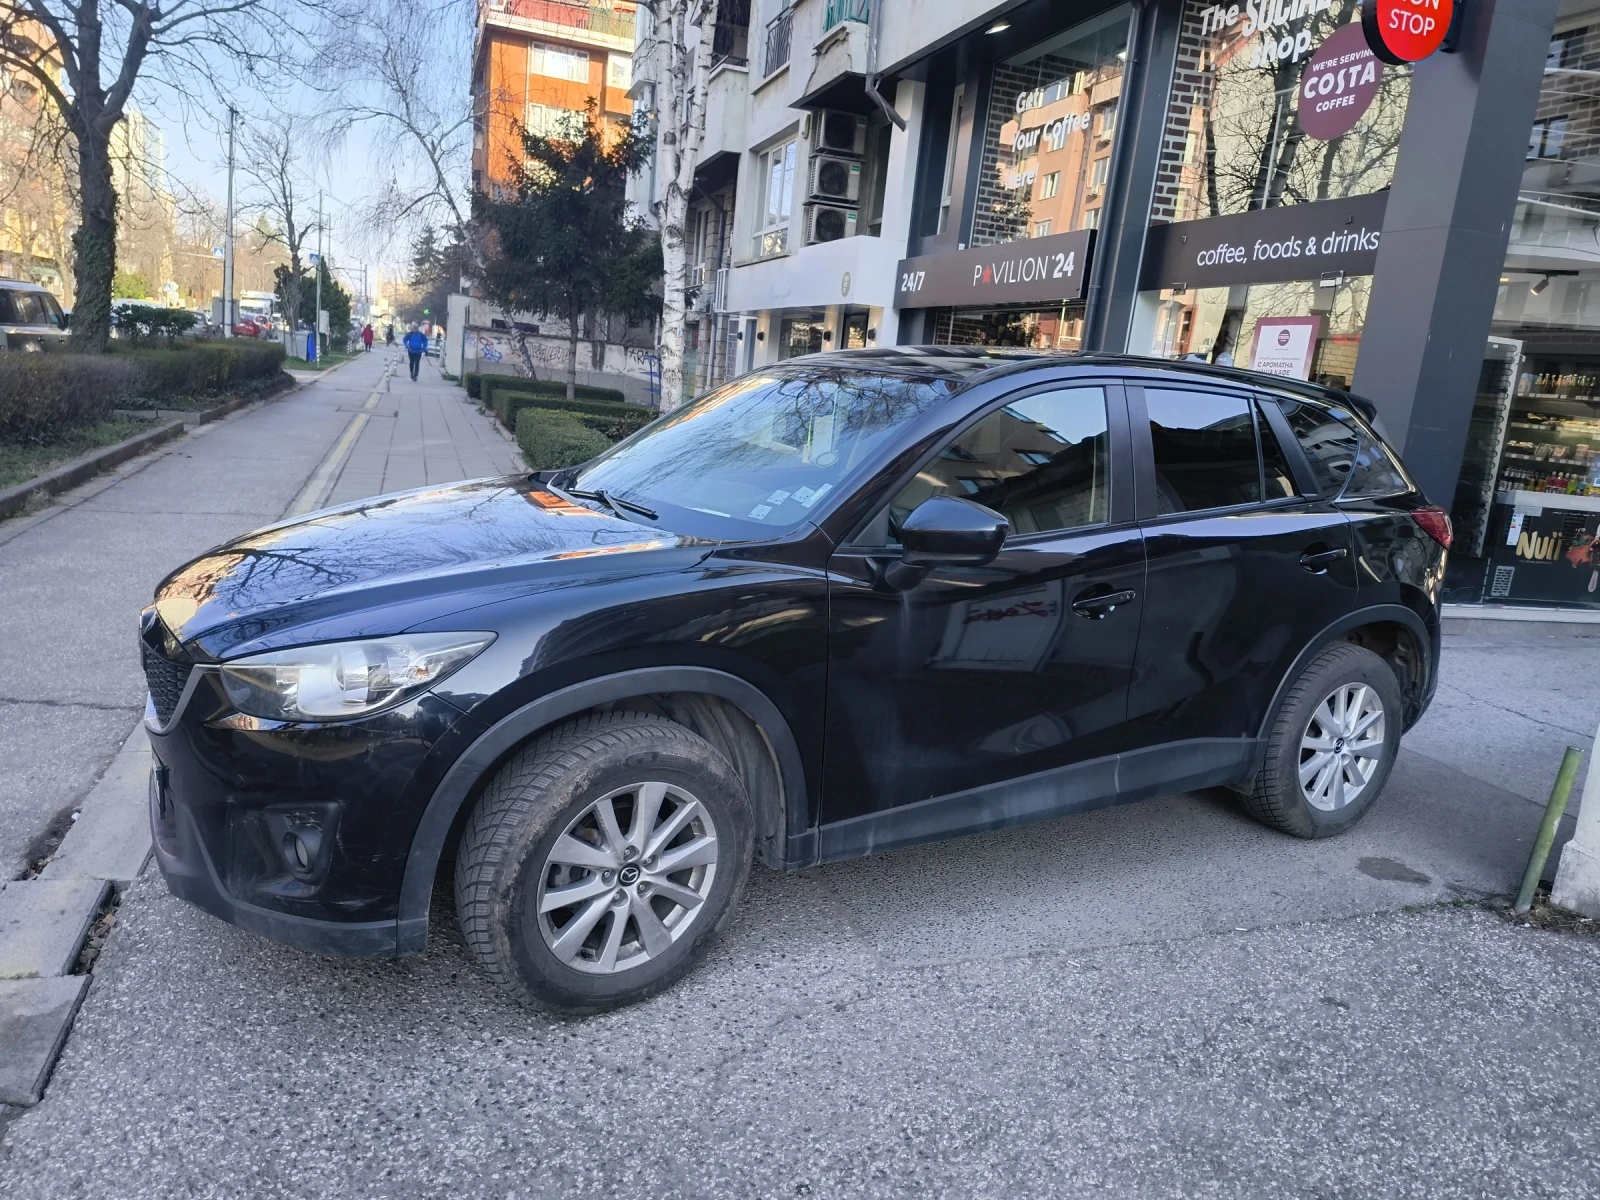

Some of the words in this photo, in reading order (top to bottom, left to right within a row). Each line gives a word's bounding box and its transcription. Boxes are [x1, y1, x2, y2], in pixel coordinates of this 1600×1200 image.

[1200, 3, 1239, 36] The
[1389, 8, 1435, 36] STOP
[1249, 27, 1311, 69] shop
[1303, 61, 1376, 99] COSTA
[1312, 58, 1338, 72] WE'RE
[1016, 88, 1040, 113] Get
[1315, 94, 1356, 112] COFFEE
[1011, 129, 1041, 152] Your
[1043, 112, 1091, 141] Coffee
[1196, 243, 1247, 266] coffee,
[1253, 236, 1302, 261] foods
[1305, 236, 1317, 256] &
[1322, 227, 1381, 254] drinks
[901, 271, 925, 292] 24/7
[1515, 531, 1563, 561] Nuii
